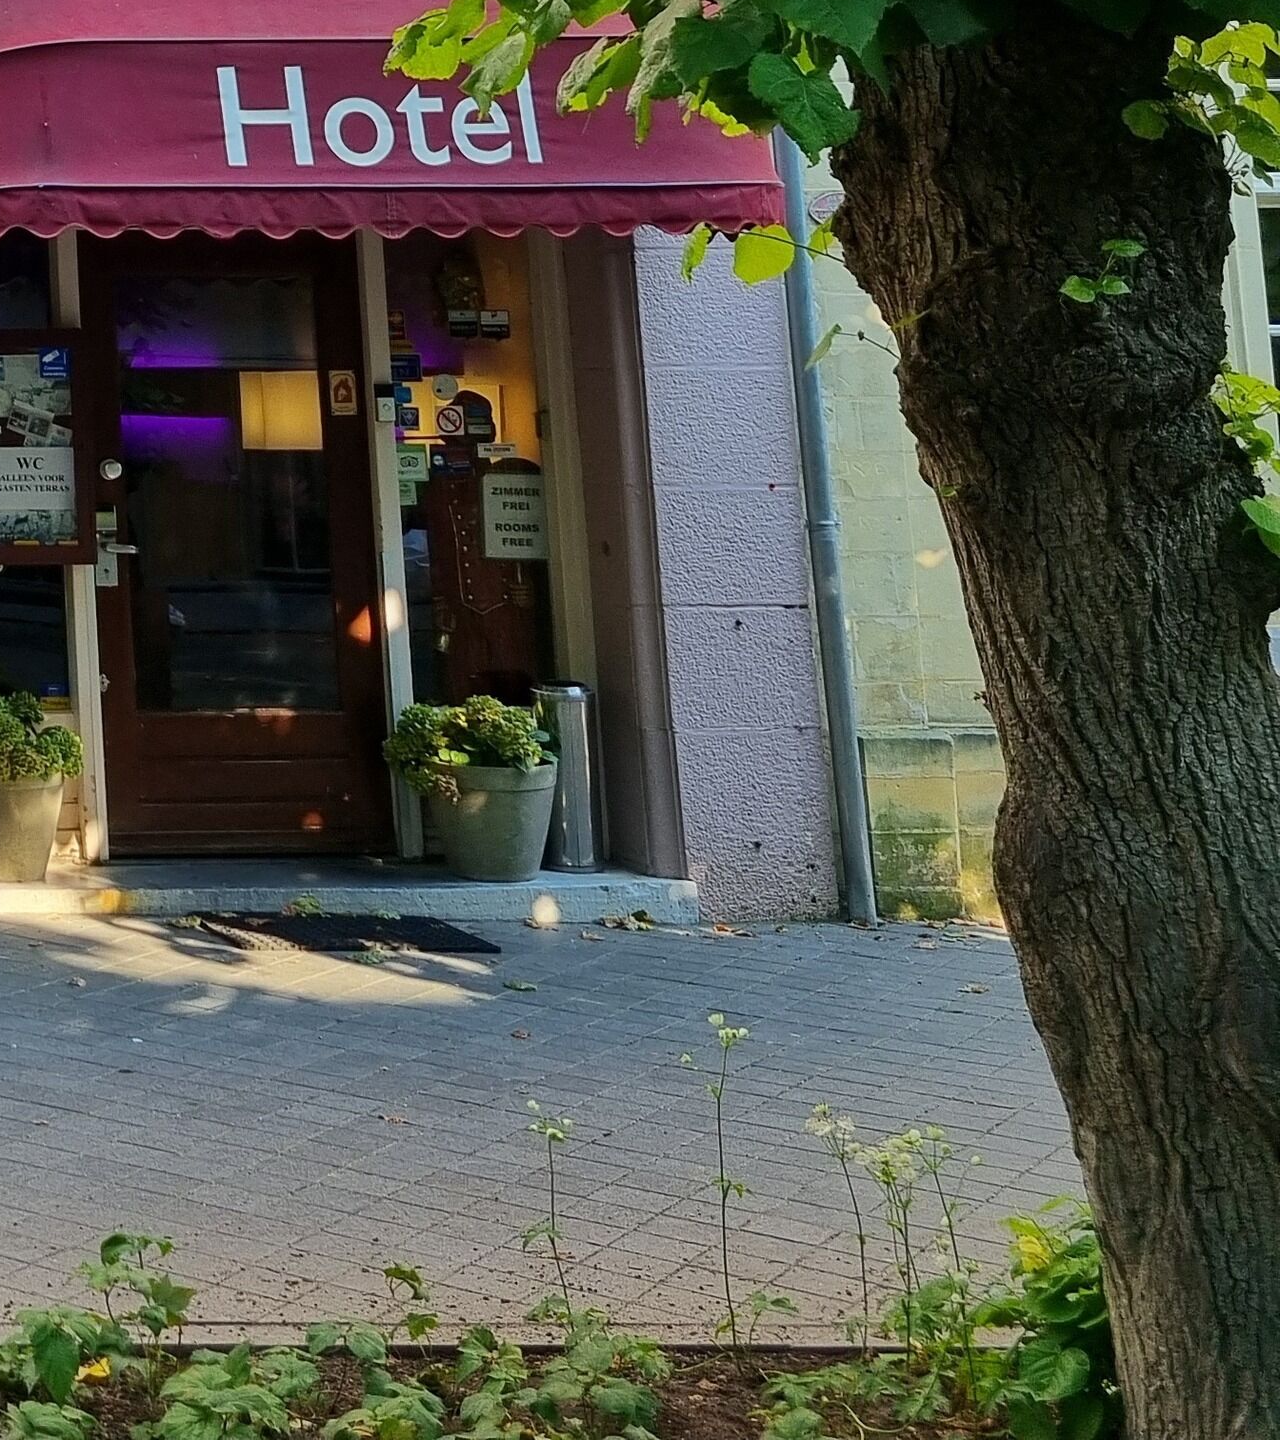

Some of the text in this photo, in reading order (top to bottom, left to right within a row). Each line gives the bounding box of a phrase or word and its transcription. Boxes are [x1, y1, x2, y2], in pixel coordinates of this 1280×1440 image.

[216, 65, 543, 167] Hotel
[16, 456, 45, 470] WC
[0, 474, 65, 482] ALLEEN VOOR
[35, 484, 70, 492] TERRAS
[491, 486, 540, 497] ZIMMER
[502, 501, 530, 511] FREI
[495, 522, 540, 533] ROOMS
[502, 538, 533, 547] FREE
